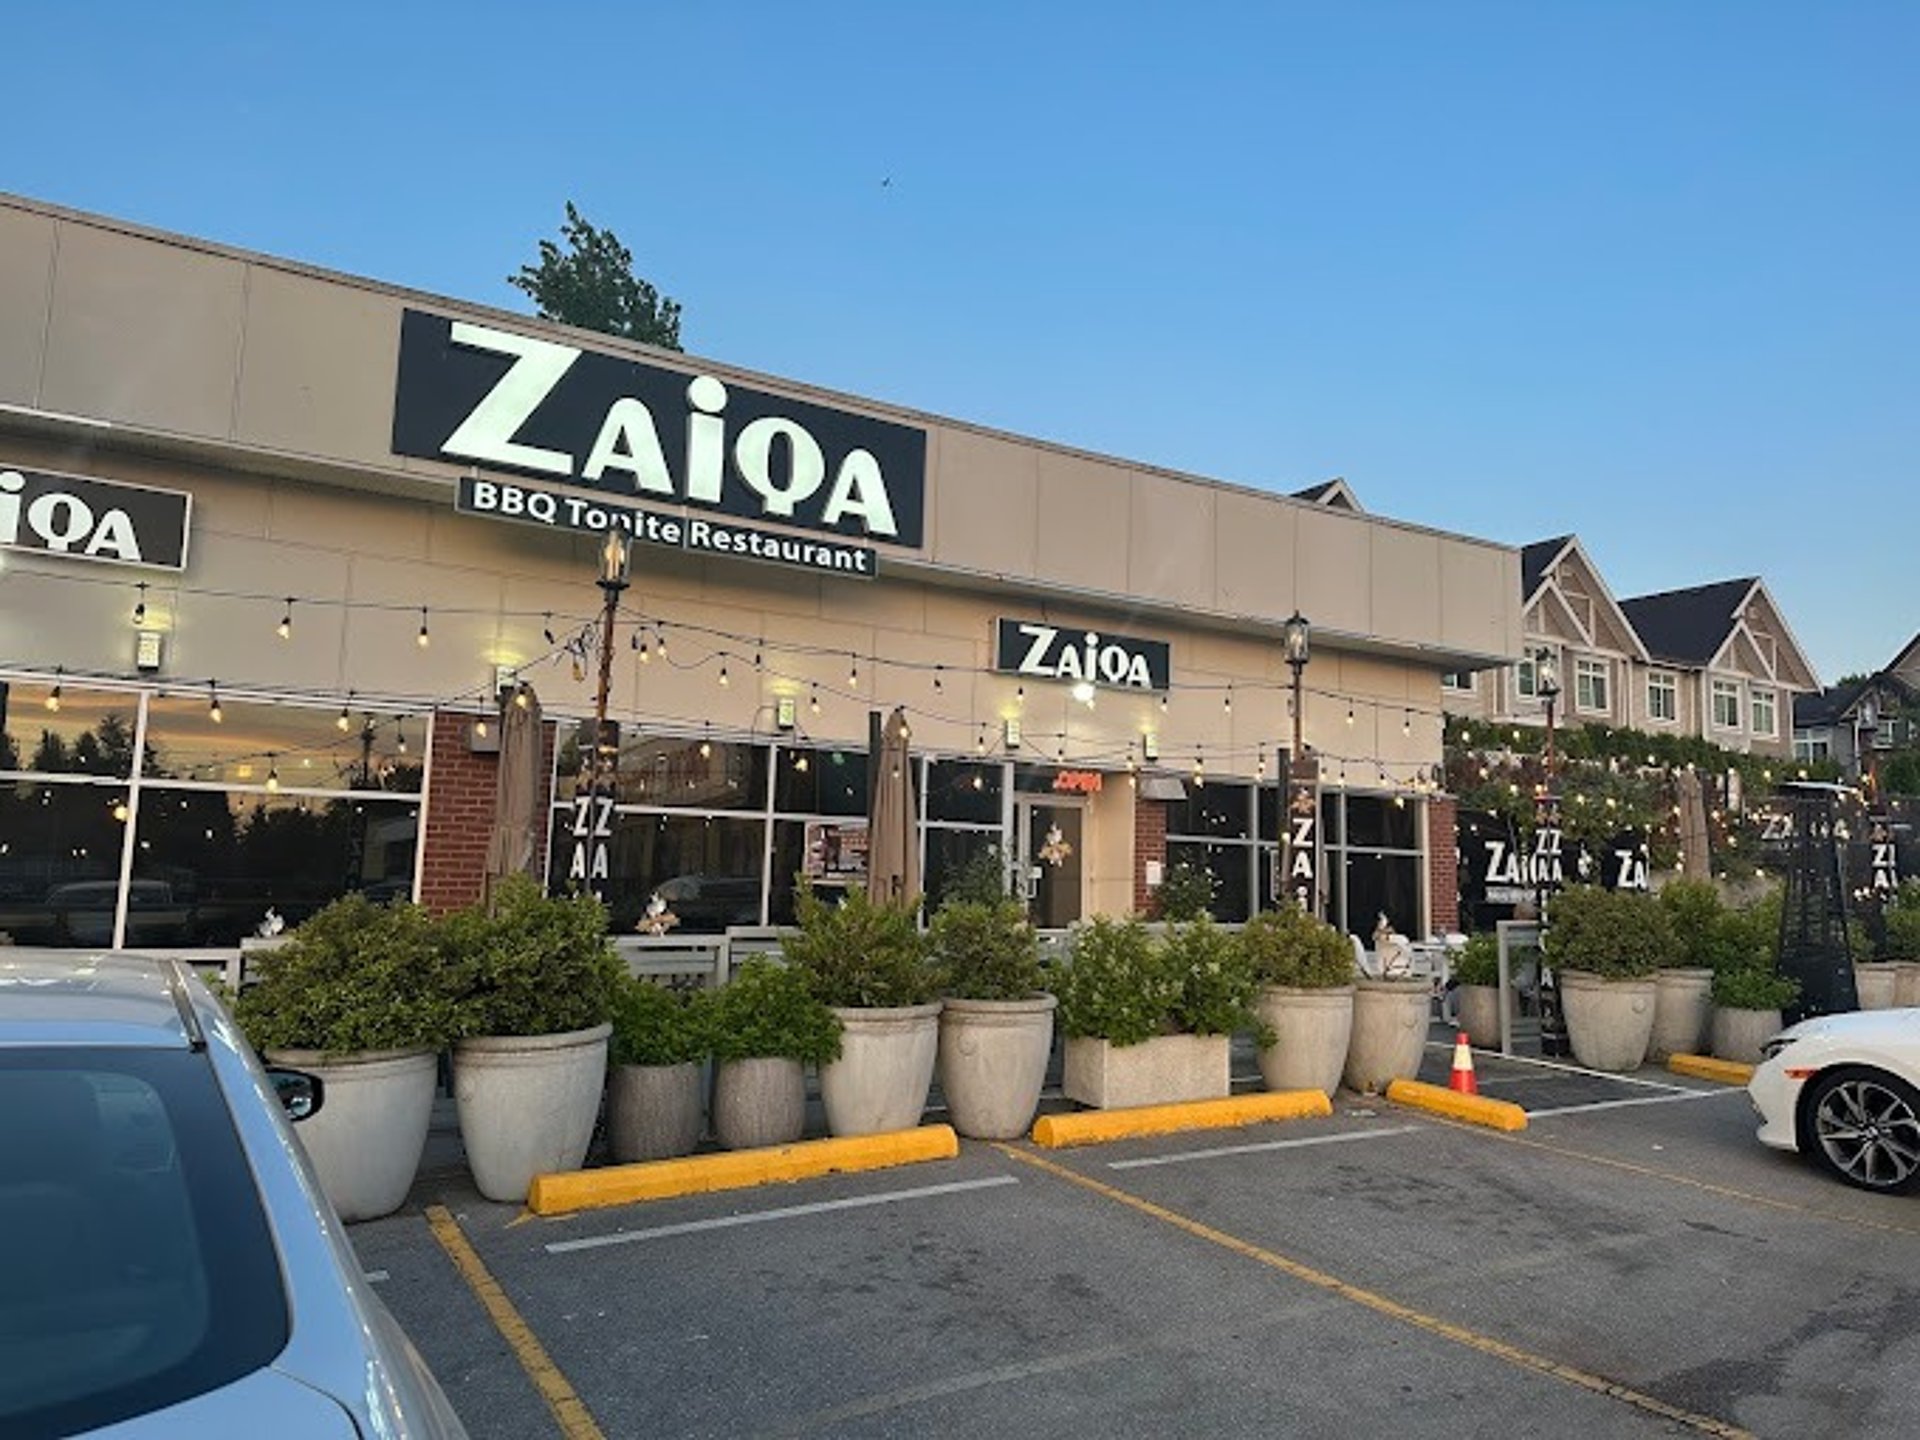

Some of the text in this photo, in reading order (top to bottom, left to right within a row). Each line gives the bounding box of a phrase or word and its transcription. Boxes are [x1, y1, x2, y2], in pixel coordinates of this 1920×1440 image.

[473, 482, 867, 572] BBQ Tonite Restaurant
